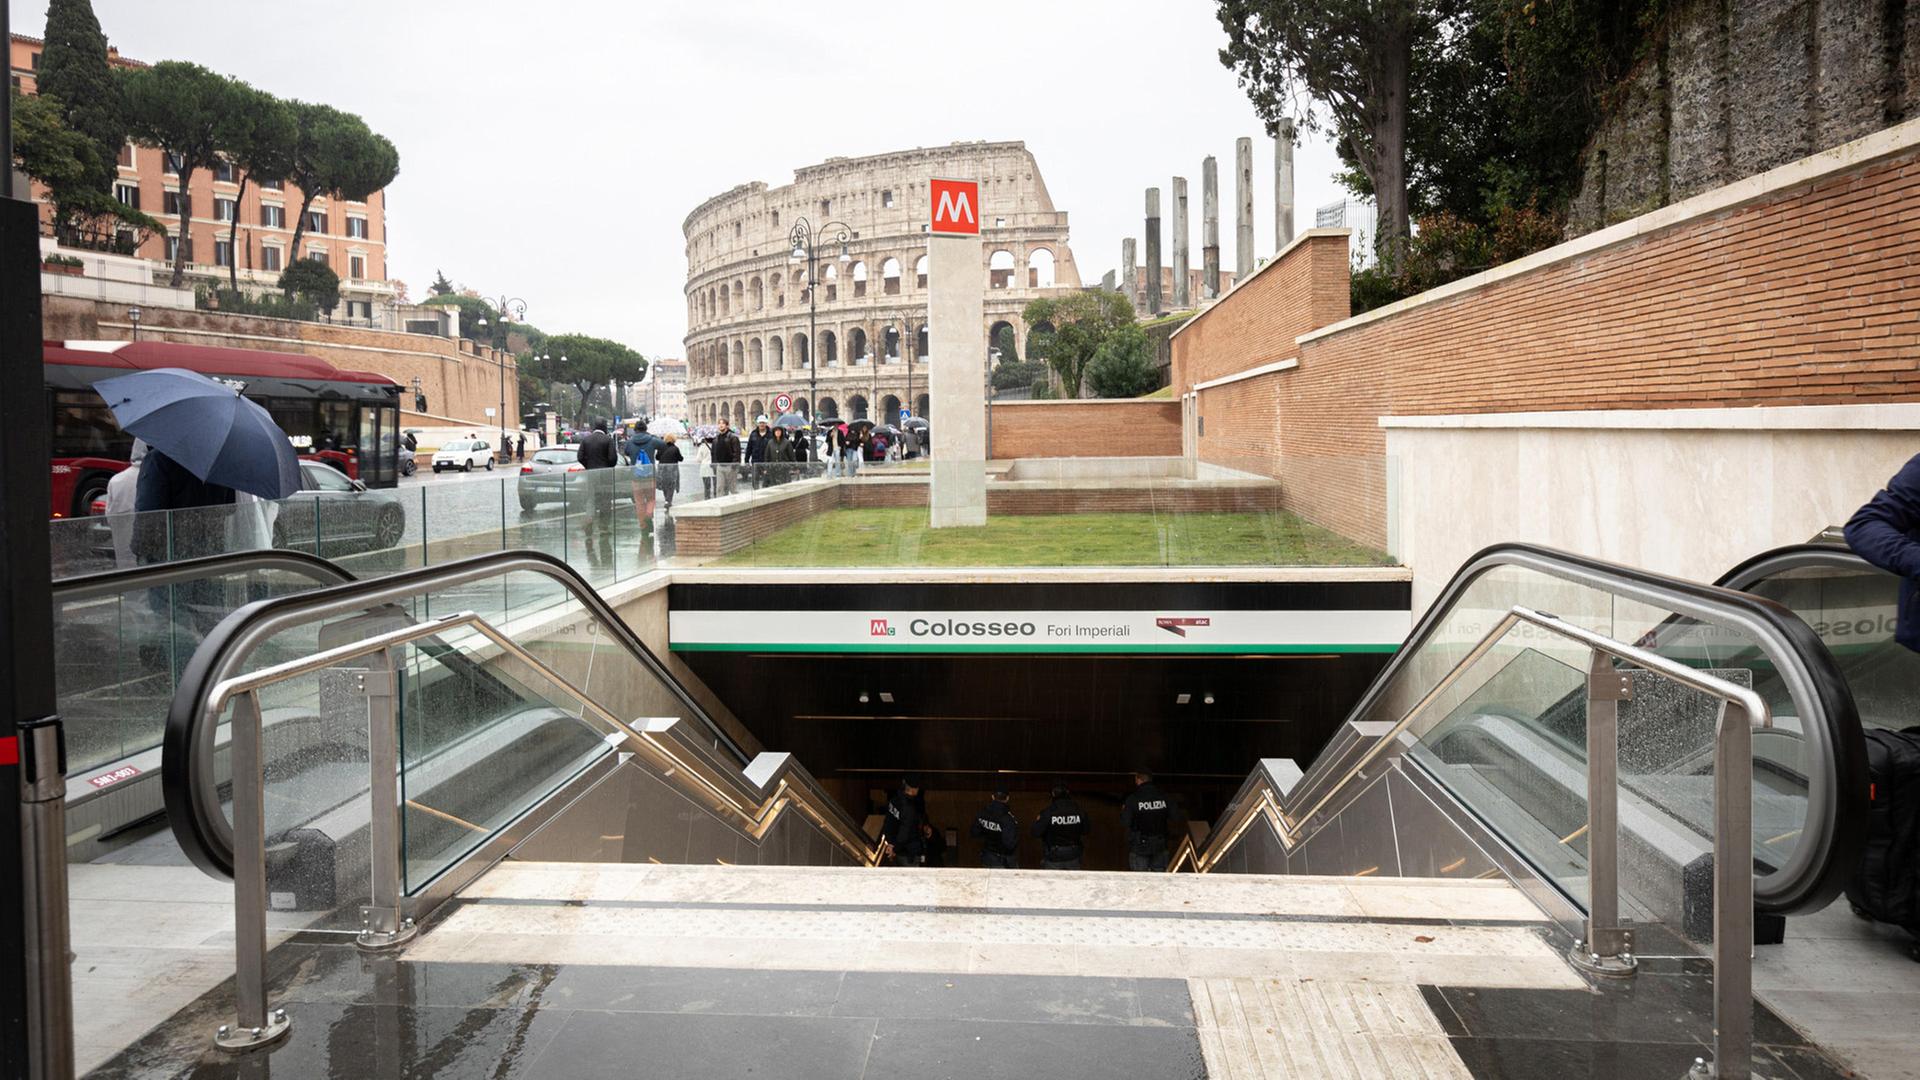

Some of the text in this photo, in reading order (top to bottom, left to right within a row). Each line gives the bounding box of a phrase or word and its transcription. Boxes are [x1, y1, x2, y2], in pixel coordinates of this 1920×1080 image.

[935, 190, 975, 224] M
[778, 398, 789, 408] 30
[872, 620, 887, 635] M
[910, 619, 1036, 636] Colosseo
[1047, 624, 1130, 638] Fori Imperiali
[1138, 800, 1167, 810] POLIZIA
[1051, 815, 1081, 825] POLIZIA
